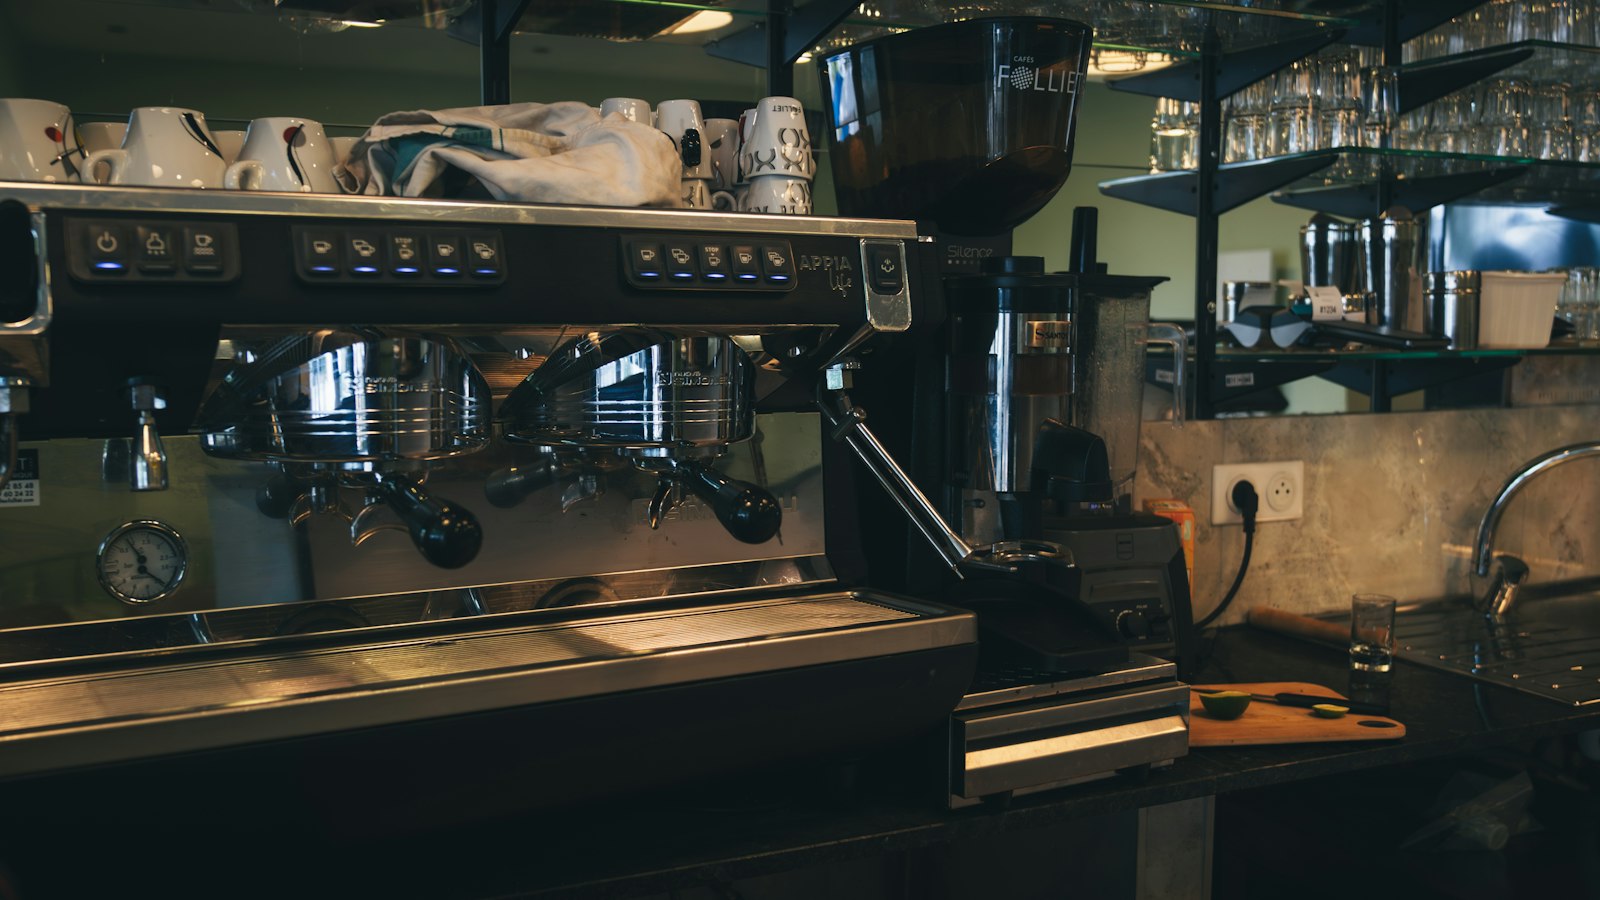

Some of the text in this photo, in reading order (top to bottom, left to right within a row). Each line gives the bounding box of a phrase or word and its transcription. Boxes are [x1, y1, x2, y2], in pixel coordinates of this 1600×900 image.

[1013, 55, 1034, 63] CAFÉS
[997, 64, 1084, 95] FOLLIET
[947, 245, 993, 258] Silence
[799, 255, 852, 270] APPIA
